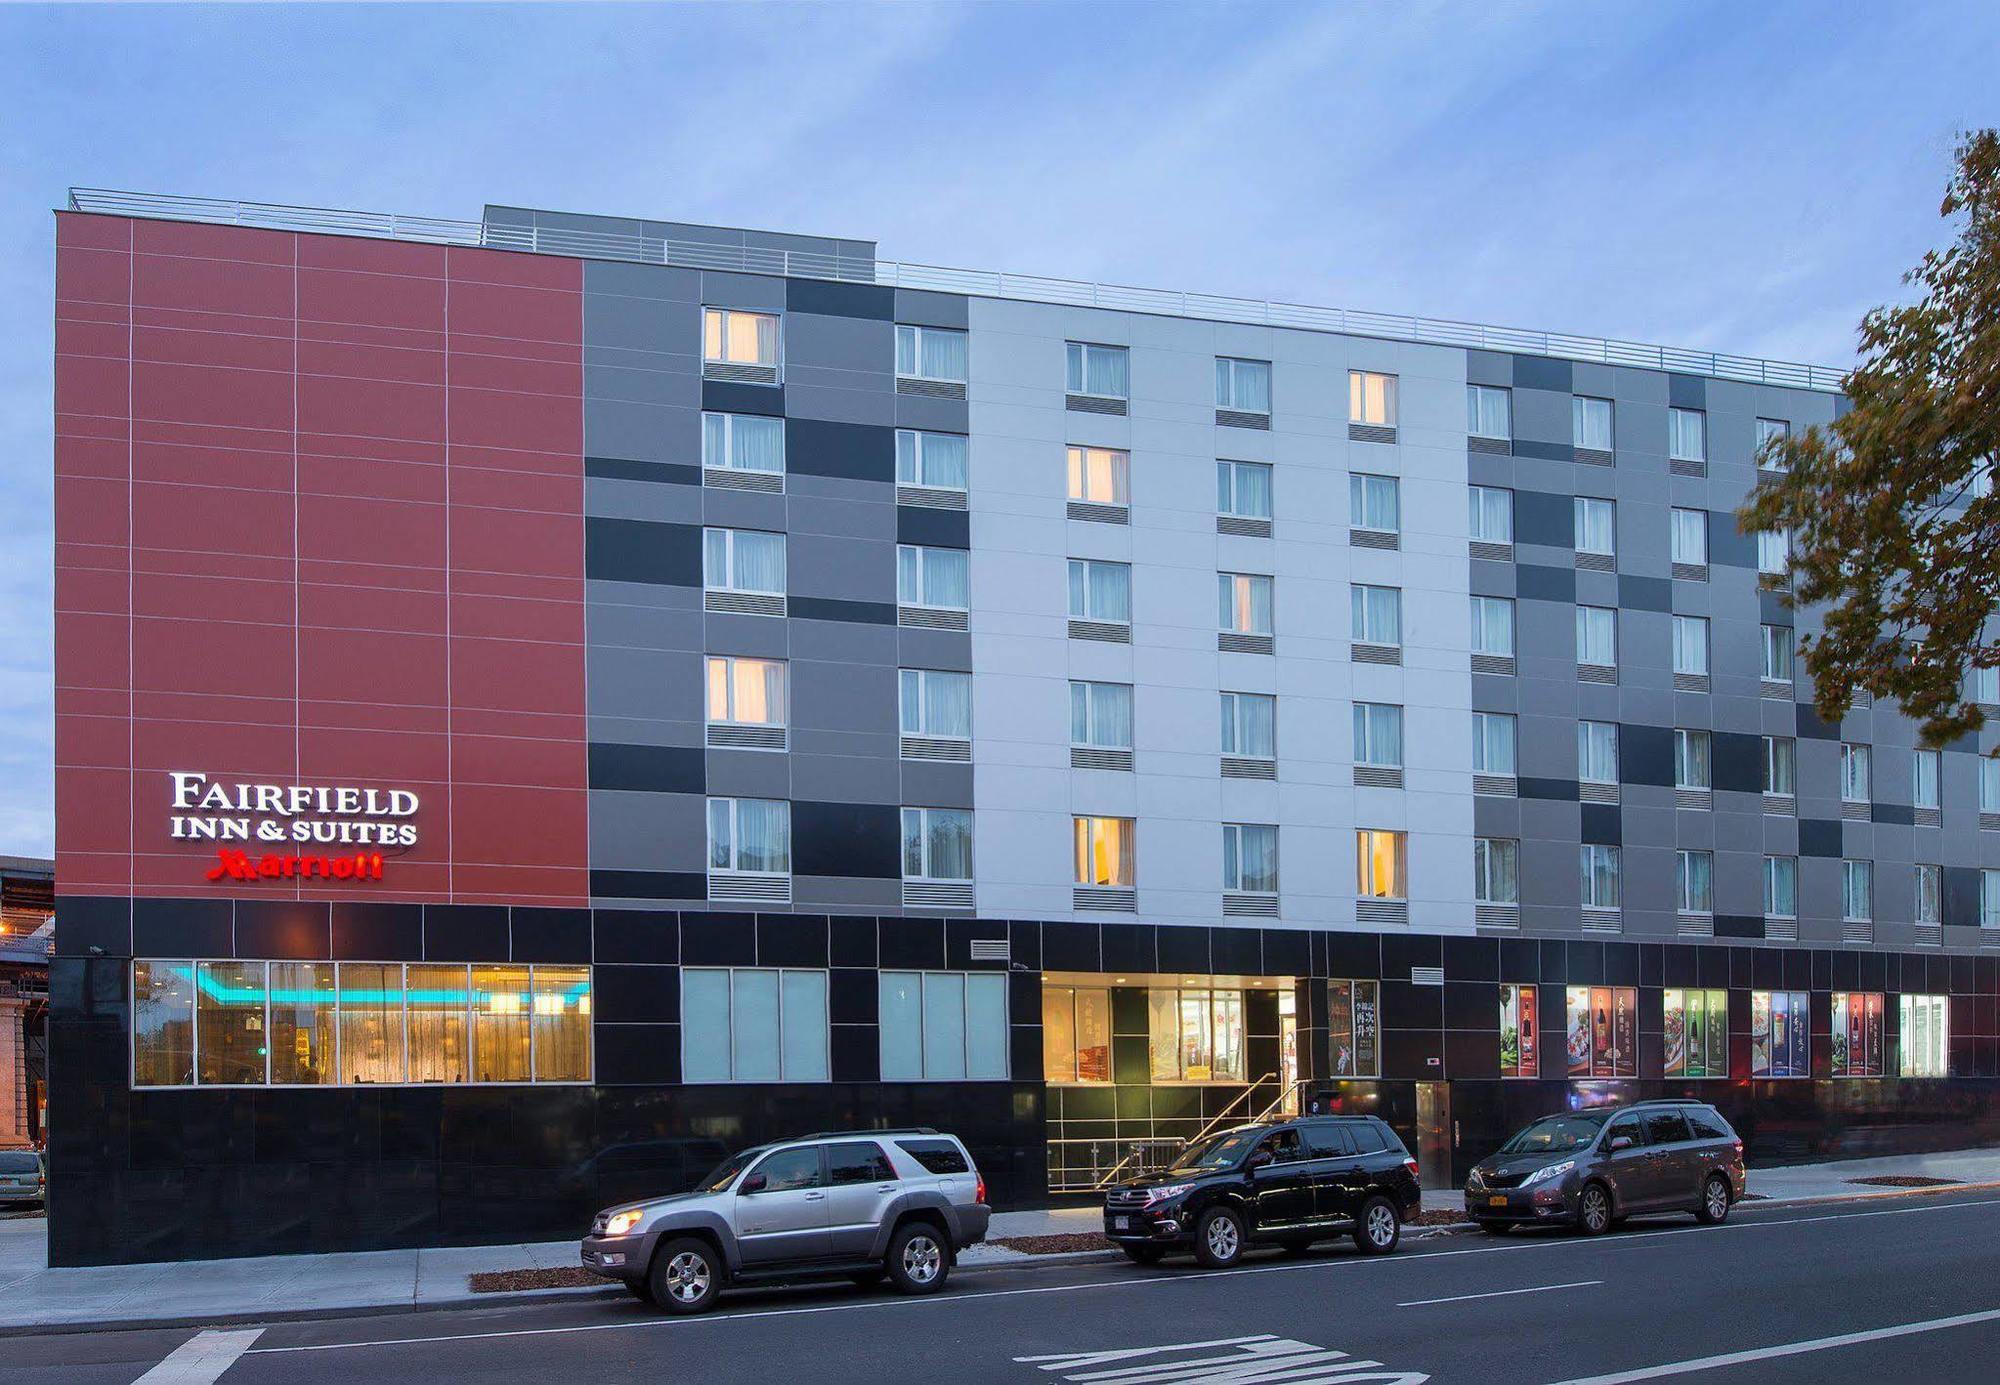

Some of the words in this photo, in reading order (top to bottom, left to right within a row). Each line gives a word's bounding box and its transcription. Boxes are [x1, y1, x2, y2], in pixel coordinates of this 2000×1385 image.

[169, 771, 419, 816] FAIRFIELD
[170, 817, 250, 840] INN
[256, 820, 288, 842] &
[292, 821, 418, 845] SUITES
[206, 848, 383, 879] Marriott
